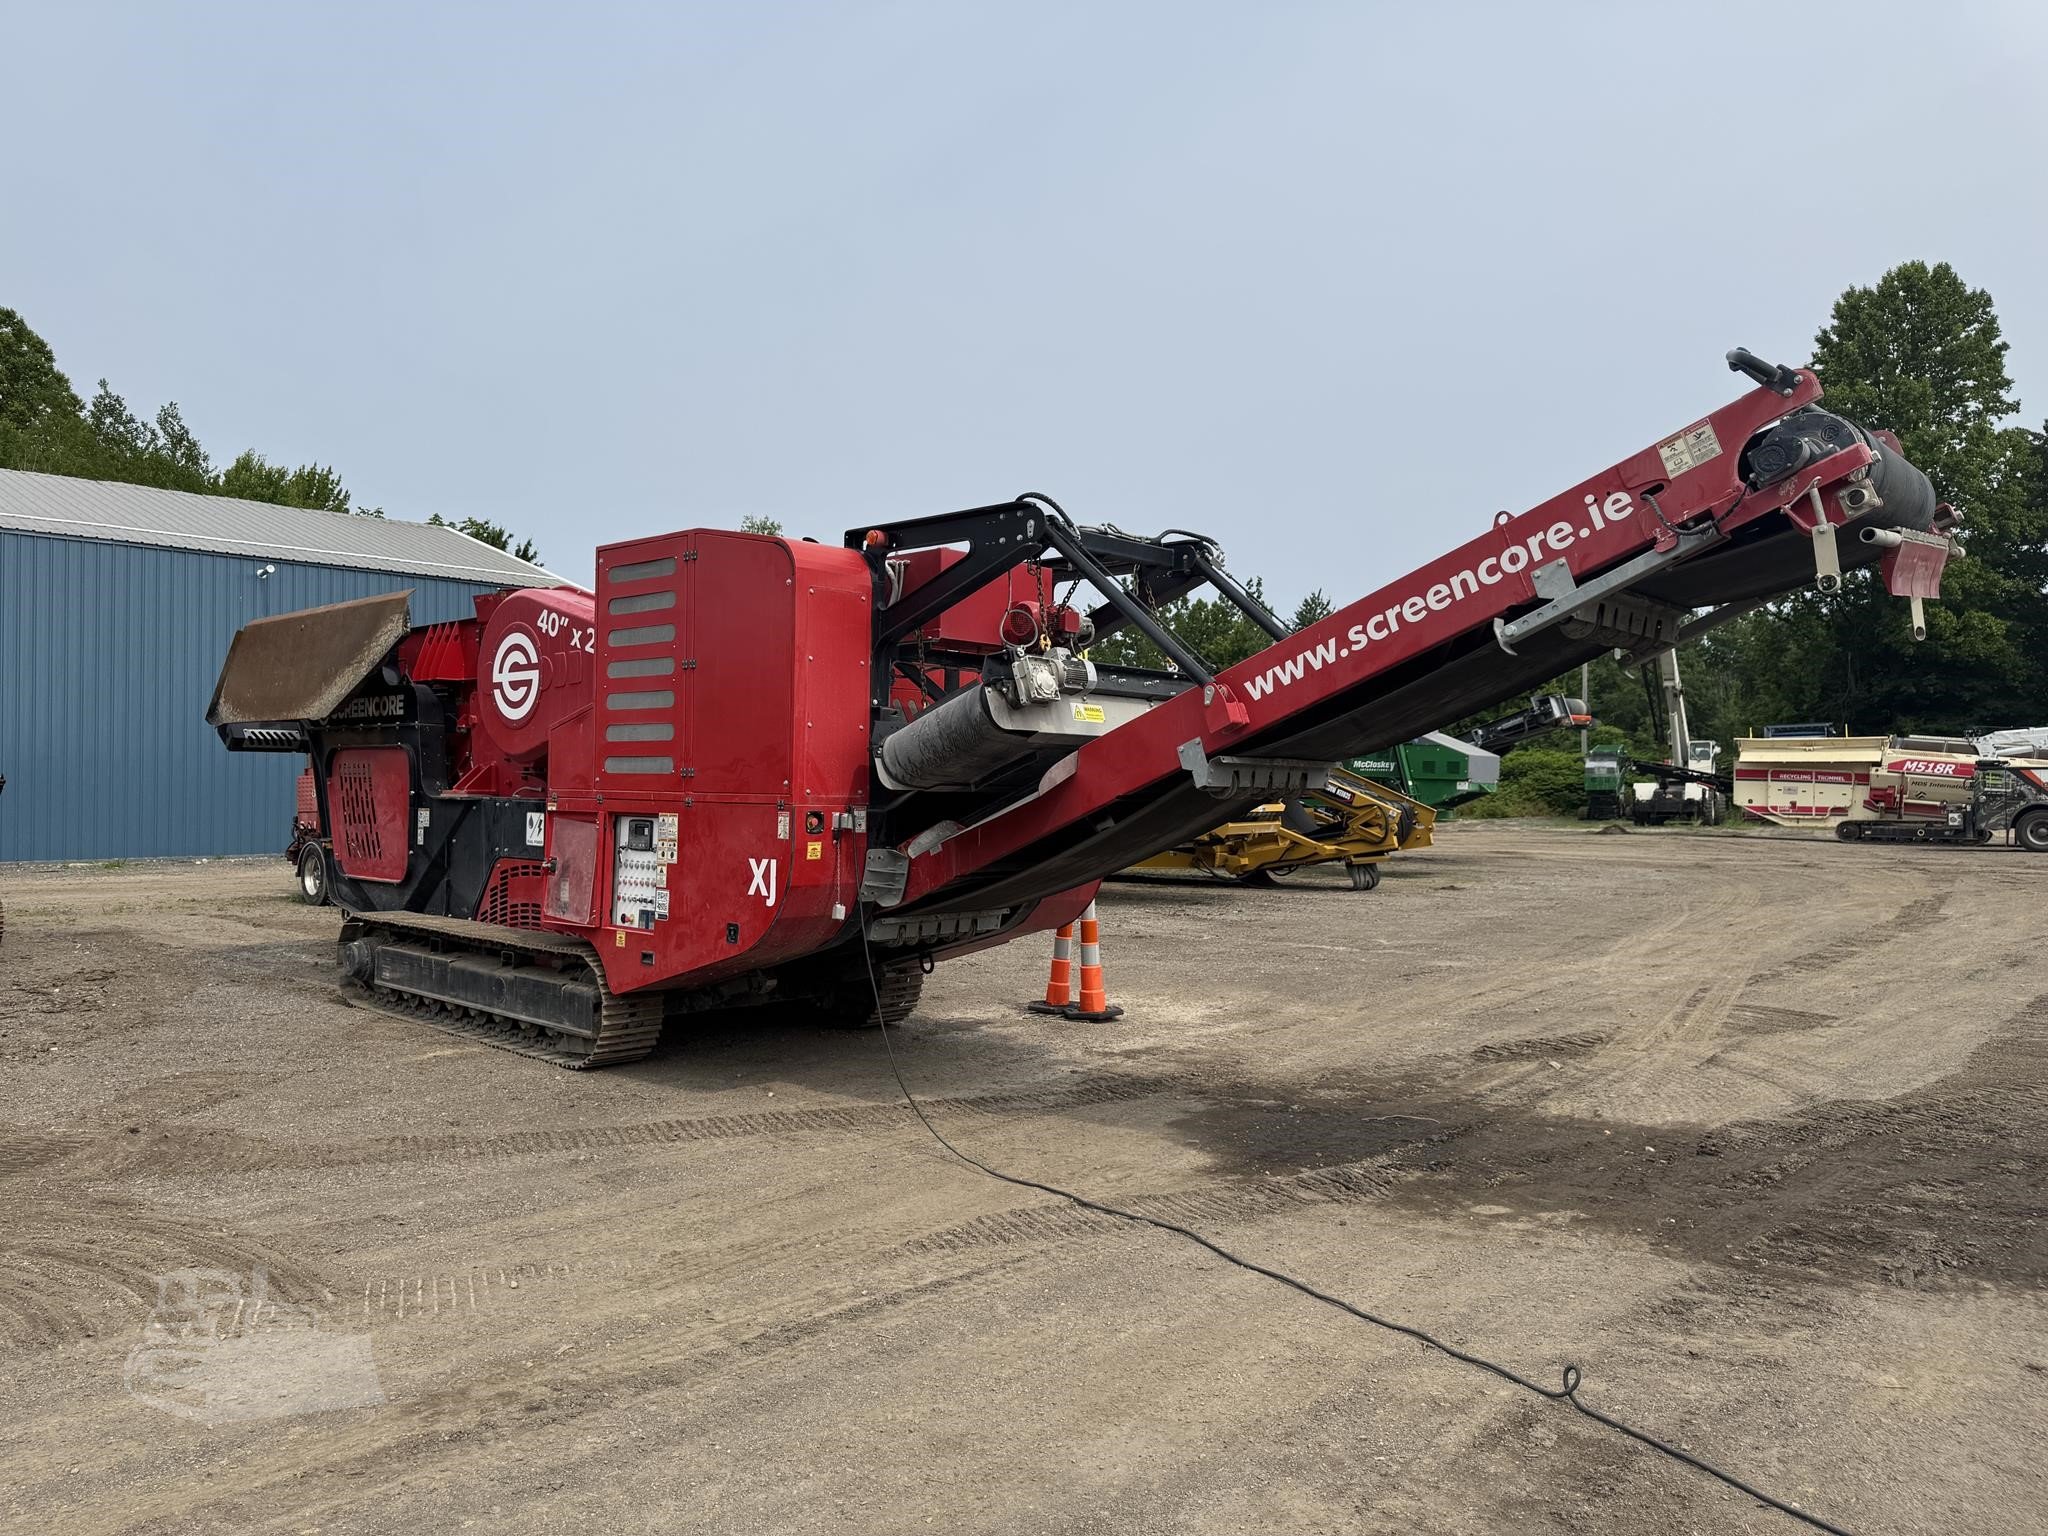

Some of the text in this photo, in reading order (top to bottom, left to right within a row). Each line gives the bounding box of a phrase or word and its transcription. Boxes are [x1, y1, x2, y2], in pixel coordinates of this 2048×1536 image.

[1243, 490, 1635, 701] www.screencore.ie
[569, 628, 583, 649] x
[1353, 760, 1396, 772] McCloskey
[1902, 760, 1956, 775] M518R
[1817, 774, 1846, 782] TROMMEL
[747, 858, 777, 907] XJ
